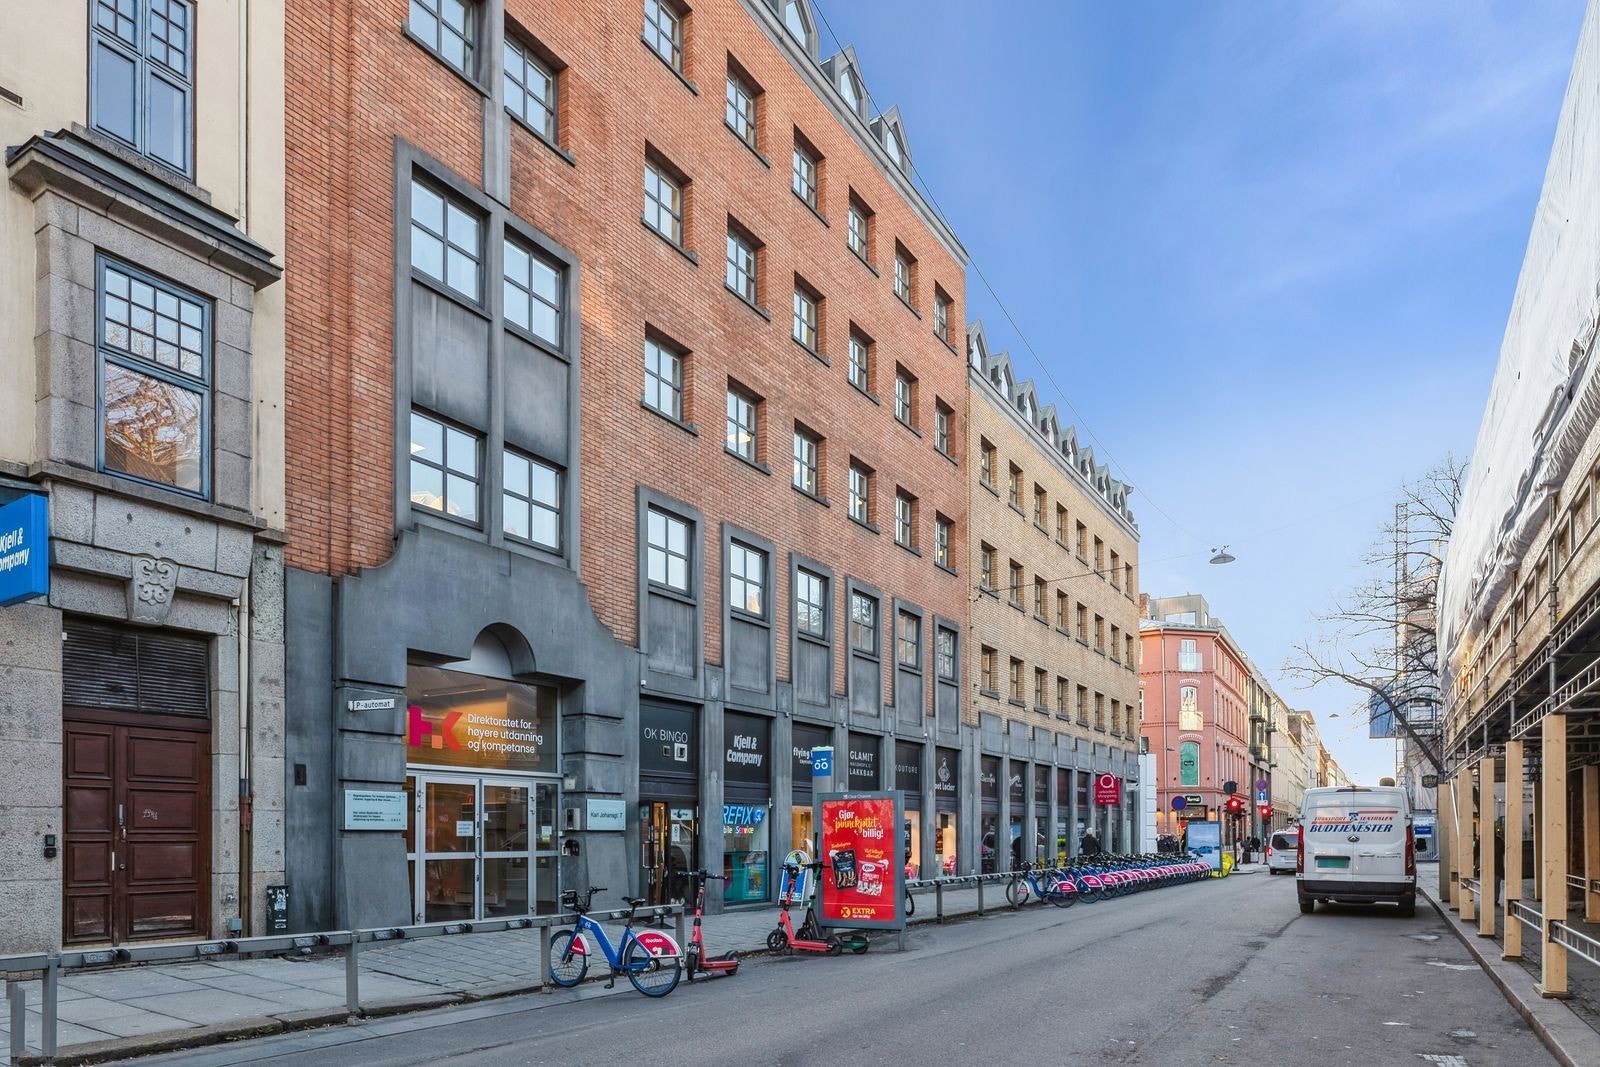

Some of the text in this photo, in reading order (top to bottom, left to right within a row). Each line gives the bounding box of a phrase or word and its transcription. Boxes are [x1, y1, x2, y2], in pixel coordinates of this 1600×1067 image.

[17, 527, 24, 545] &
[0, 548, 30, 571] ompany
[356, 701, 391, 709] P-automat
[468, 714, 532, 729] Direktoratet for
[468, 727, 543, 745] høyere utdanning
[644, 727, 688, 743] OK BINGO
[468, 740, 535, 754] og kompetanse
[734, 735, 757, 750] Kjell &
[727, 749, 763, 766] Company
[793, 746, 810, 759] flying
[849, 750, 874, 762] GLAMIT
[849, 767, 874, 777] LAKKBAR
[838, 810, 855, 820] Gjør
[835, 816, 879, 833] pinnekjøttet
[1310, 824, 1393, 833] BUDTJENESTER
[862, 828, 884, 840] billig!
[852, 907, 876, 915] EXTRA
